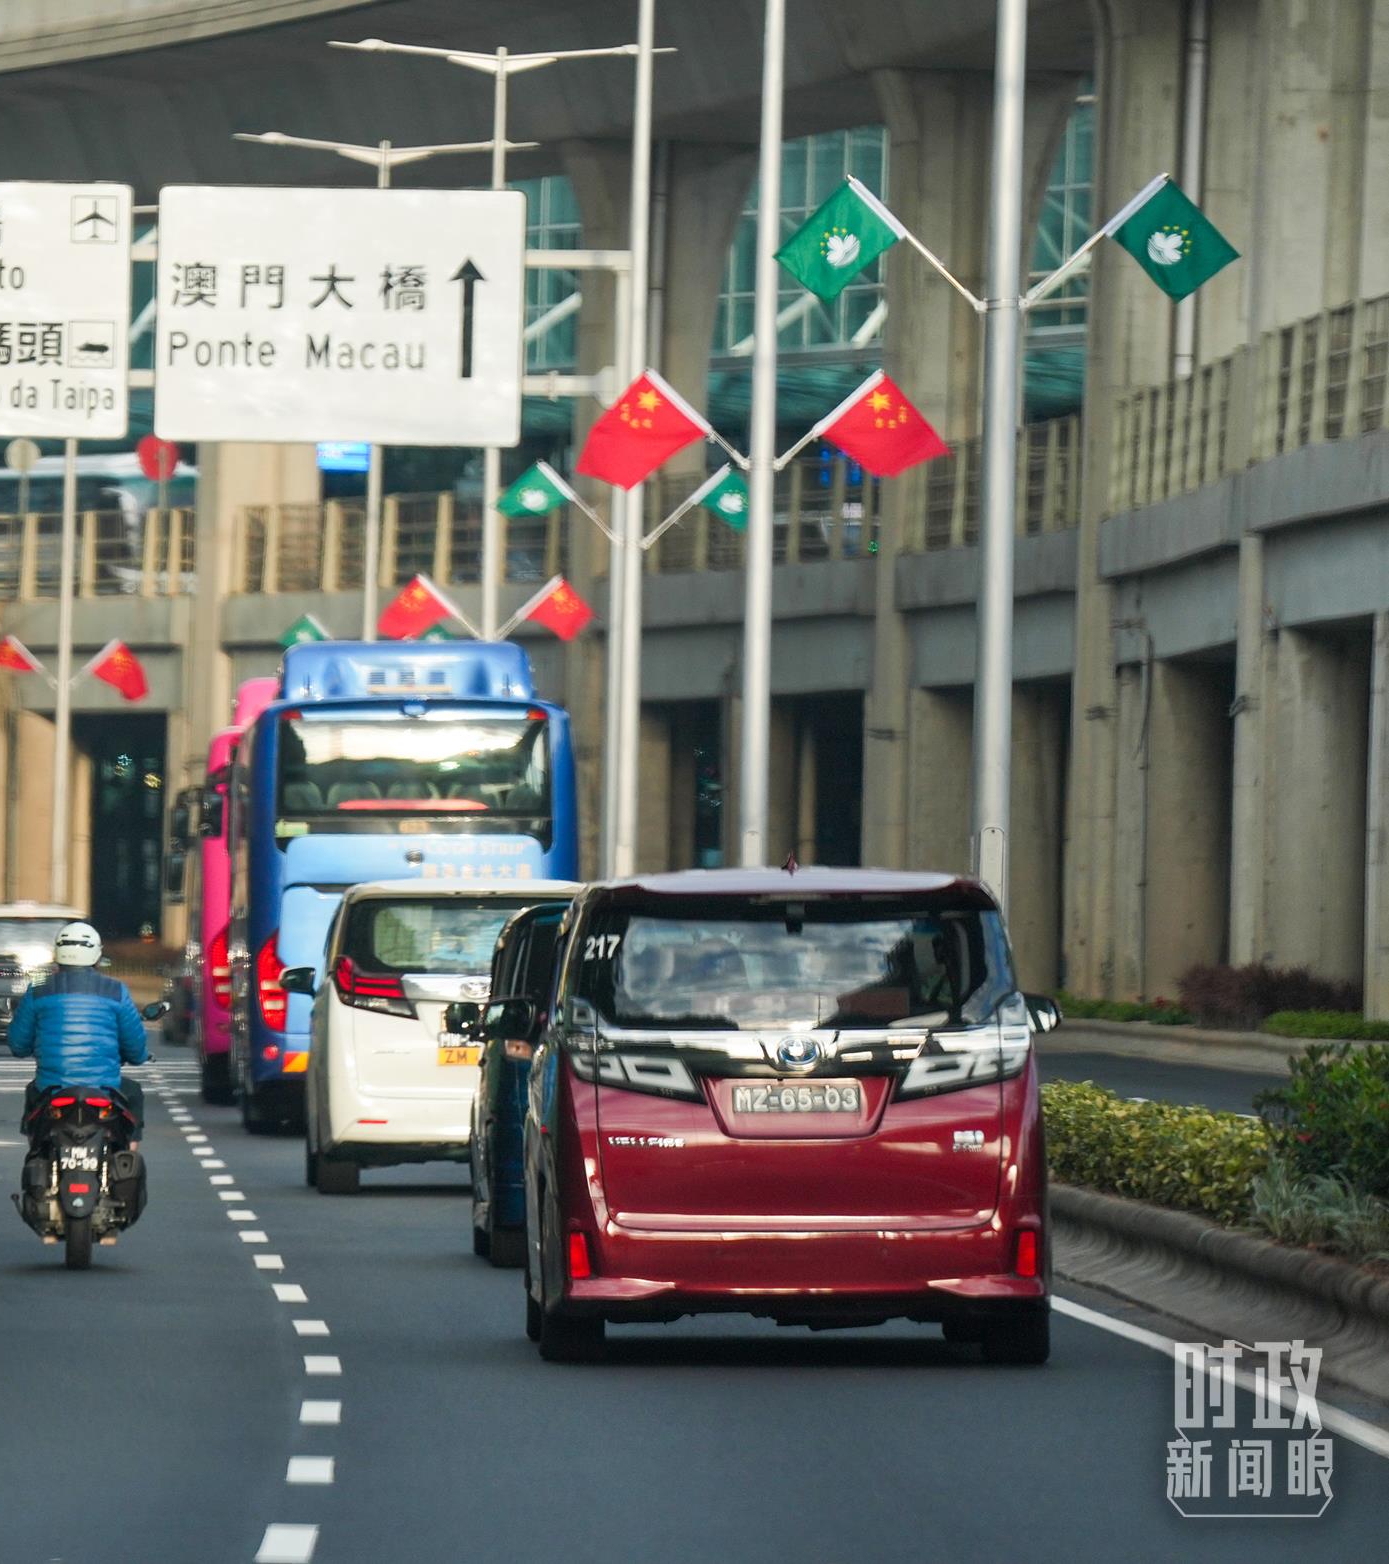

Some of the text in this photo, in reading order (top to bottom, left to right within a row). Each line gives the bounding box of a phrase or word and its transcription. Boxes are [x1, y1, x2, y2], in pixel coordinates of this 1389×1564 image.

[171, 261, 428, 311] 澳門大橋
[168, 330, 426, 370] Ponte Macau
[10, 378, 38, 410] da
[49, 378, 115, 420] Taipa
[584, 934, 621, 961] 217
[735, 1086, 859, 1112] MZ-65-03
